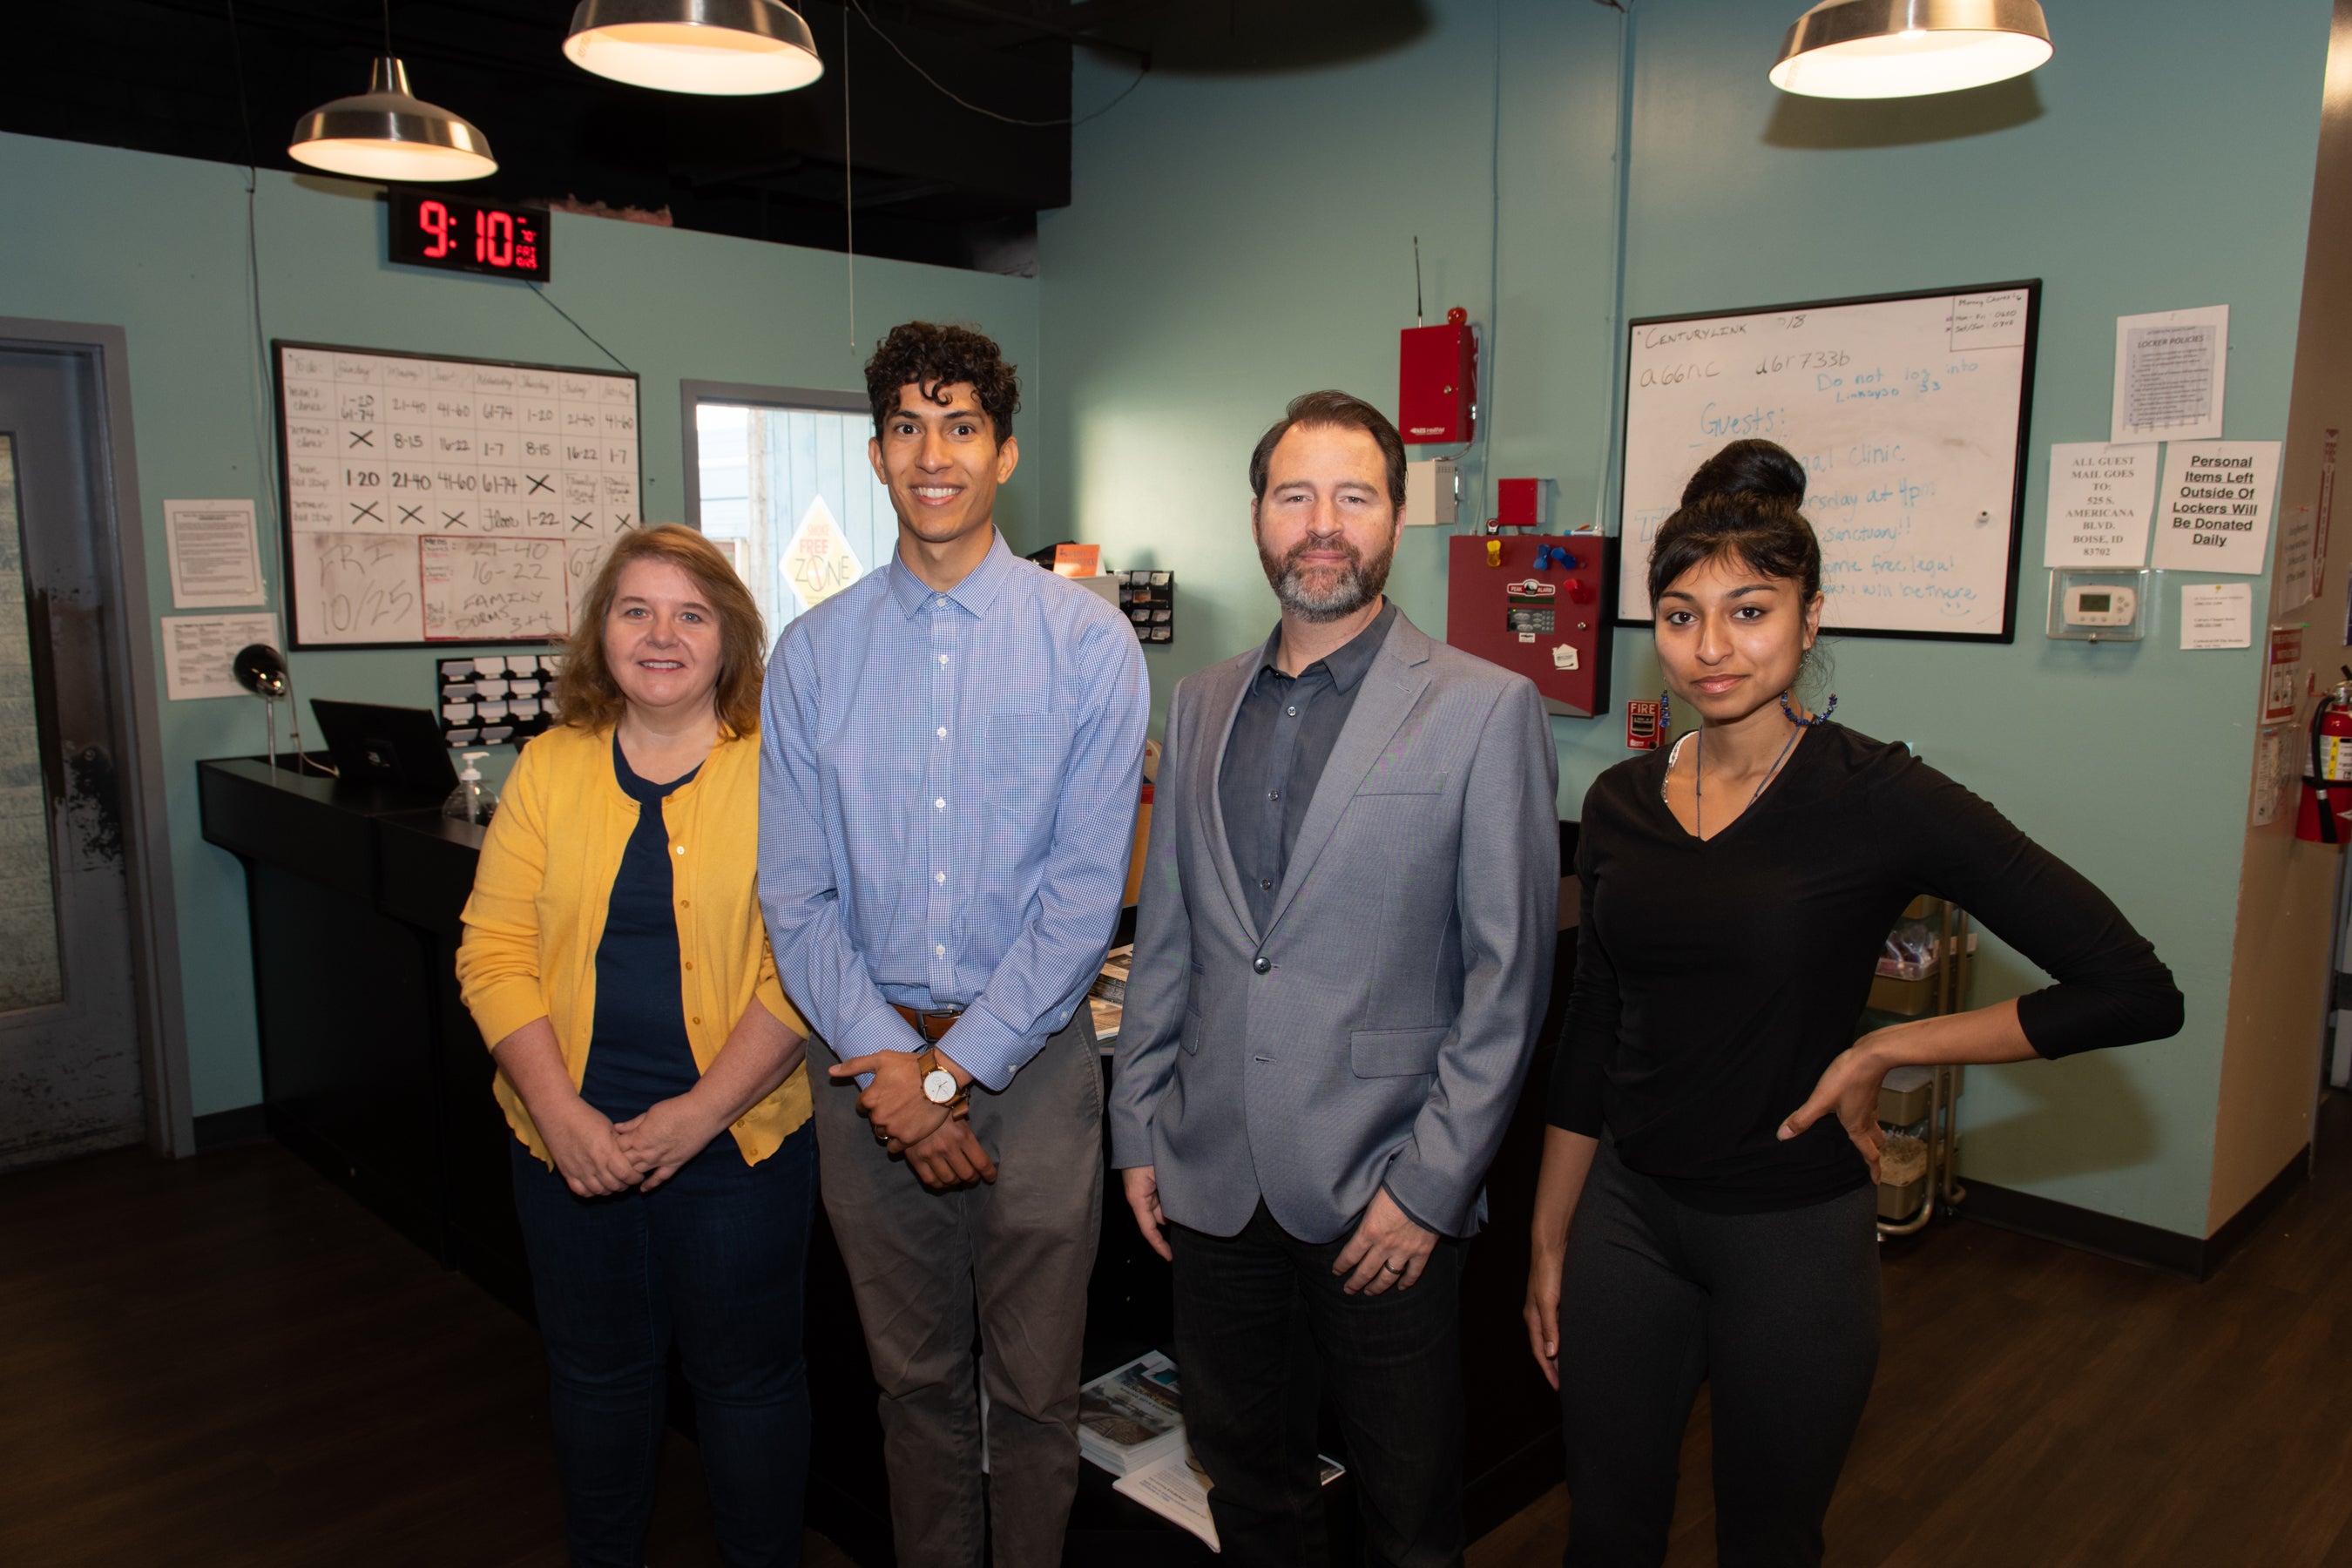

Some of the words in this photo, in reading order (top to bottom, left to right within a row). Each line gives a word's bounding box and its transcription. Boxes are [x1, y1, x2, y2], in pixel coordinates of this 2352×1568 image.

[420, 199, 512, 267] 9:10
[1817, 373, 1843, 391] Do
[1855, 367, 1884, 384] not
[1946, 359, 1979, 375] into
[392, 397, 427, 414] 21-40
[393, 432, 424, 449] 8-15
[484, 443, 504, 456] 1-7
[525, 442, 551, 456] 8-15
[610, 448, 627, 464] 1-7
[2099, 456, 2135, 466] GUEST
[2191, 456, 2253, 467] Personal
[392, 470, 432, 490] 21-40
[2105, 470, 2135, 478] GOES
[2186, 471, 2222, 483] Items
[2227, 472, 2254, 483] Left
[1866, 483, 1894, 504] at
[2180, 486, 2234, 498] Outside
[2238, 488, 2254, 499] Of
[2065, 509, 2134, 517] AMERICANA
[2173, 502, 2227, 514] Lockers
[2232, 504, 2258, 515] Will
[526, 508, 561, 527] 1-22
[2173, 517, 2191, 528] Be
[2195, 518, 2253, 531] Donated
[800, 539, 828, 554] FREE
[2193, 533, 2227, 547] Daily
[1871, 554, 1907, 575] free
[472, 560, 551, 585] 16-22
[795, 555, 850, 591] ZONE
[321, 579, 414, 635] 10/25
[1631, 703, 1656, 713] FIRE
